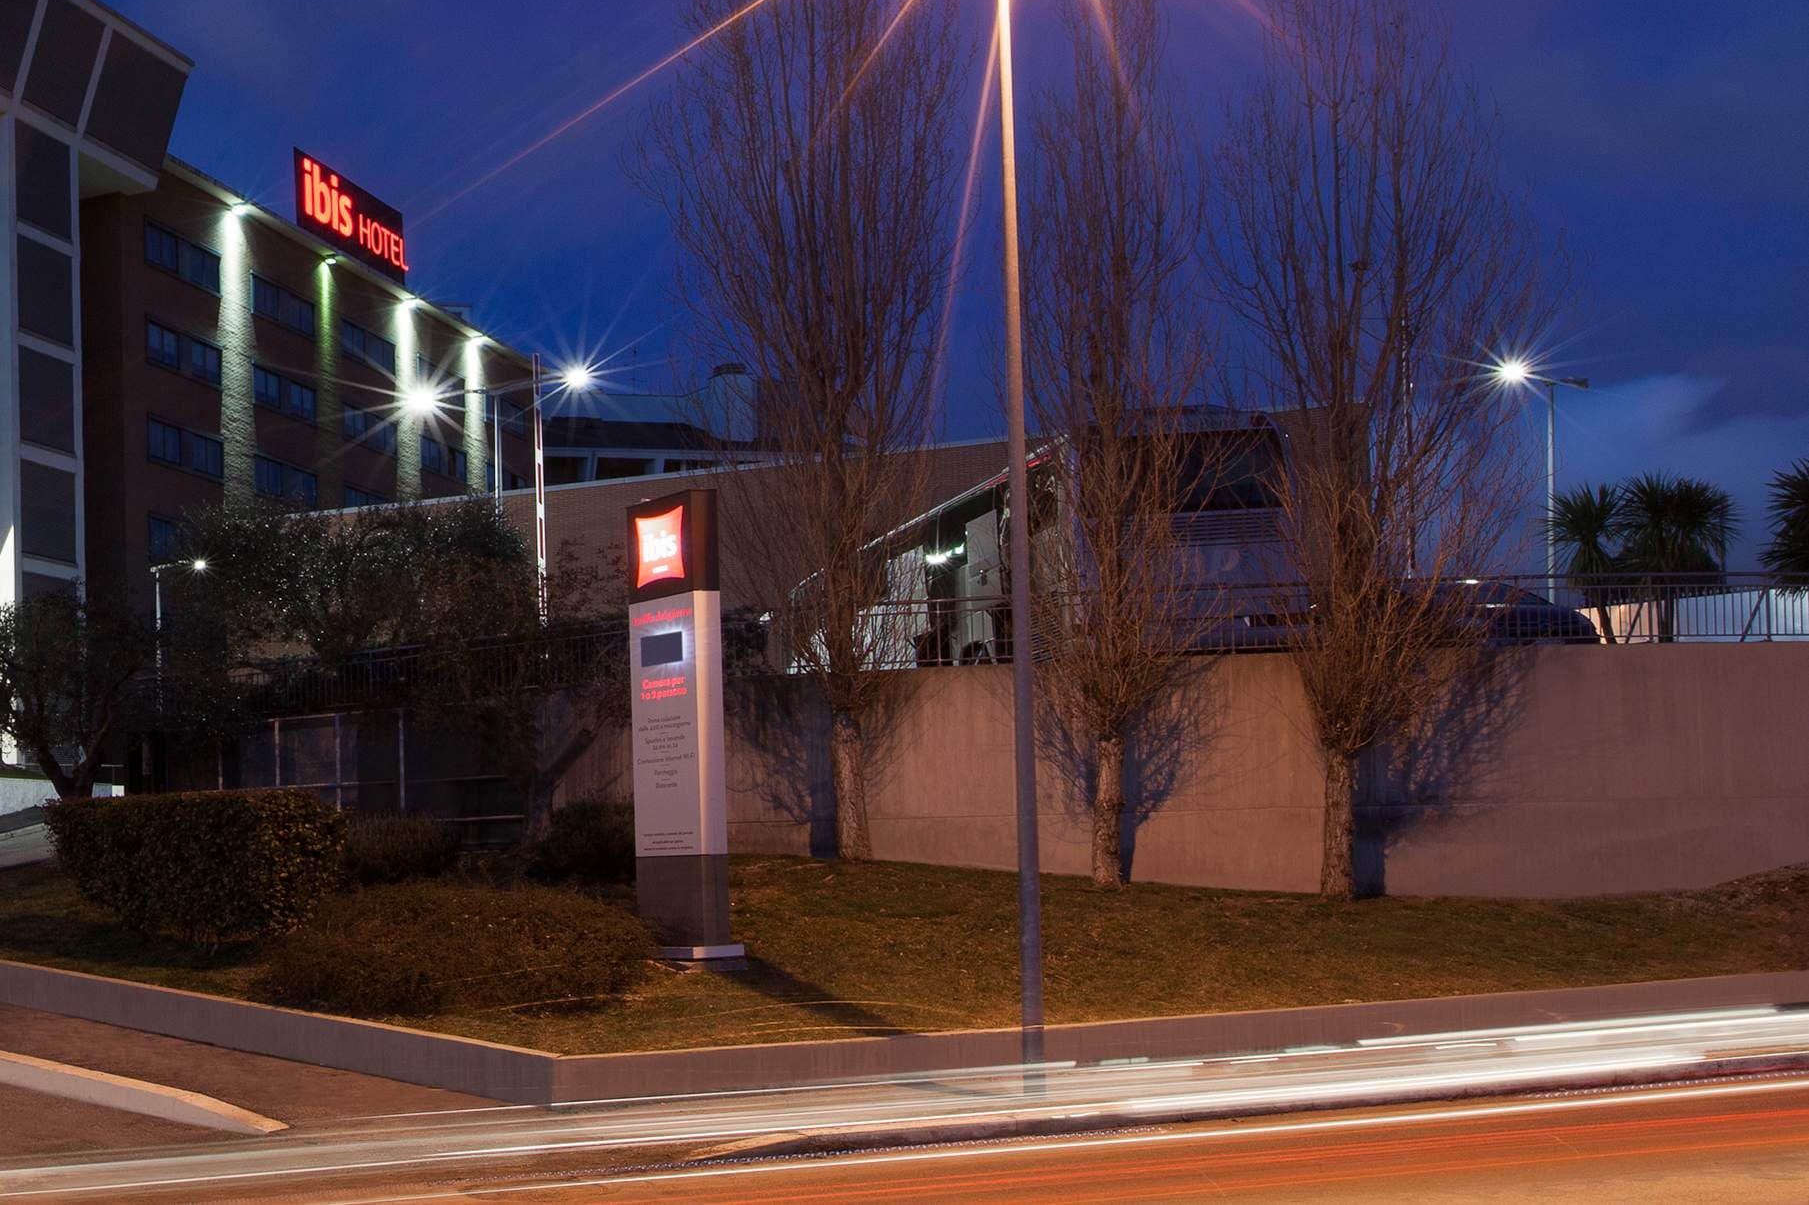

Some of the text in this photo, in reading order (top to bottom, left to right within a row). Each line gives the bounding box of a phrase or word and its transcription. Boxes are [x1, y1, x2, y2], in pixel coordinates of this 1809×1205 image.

[303, 158, 409, 271] ibis HOTEL
[643, 530, 677, 563] ibis
